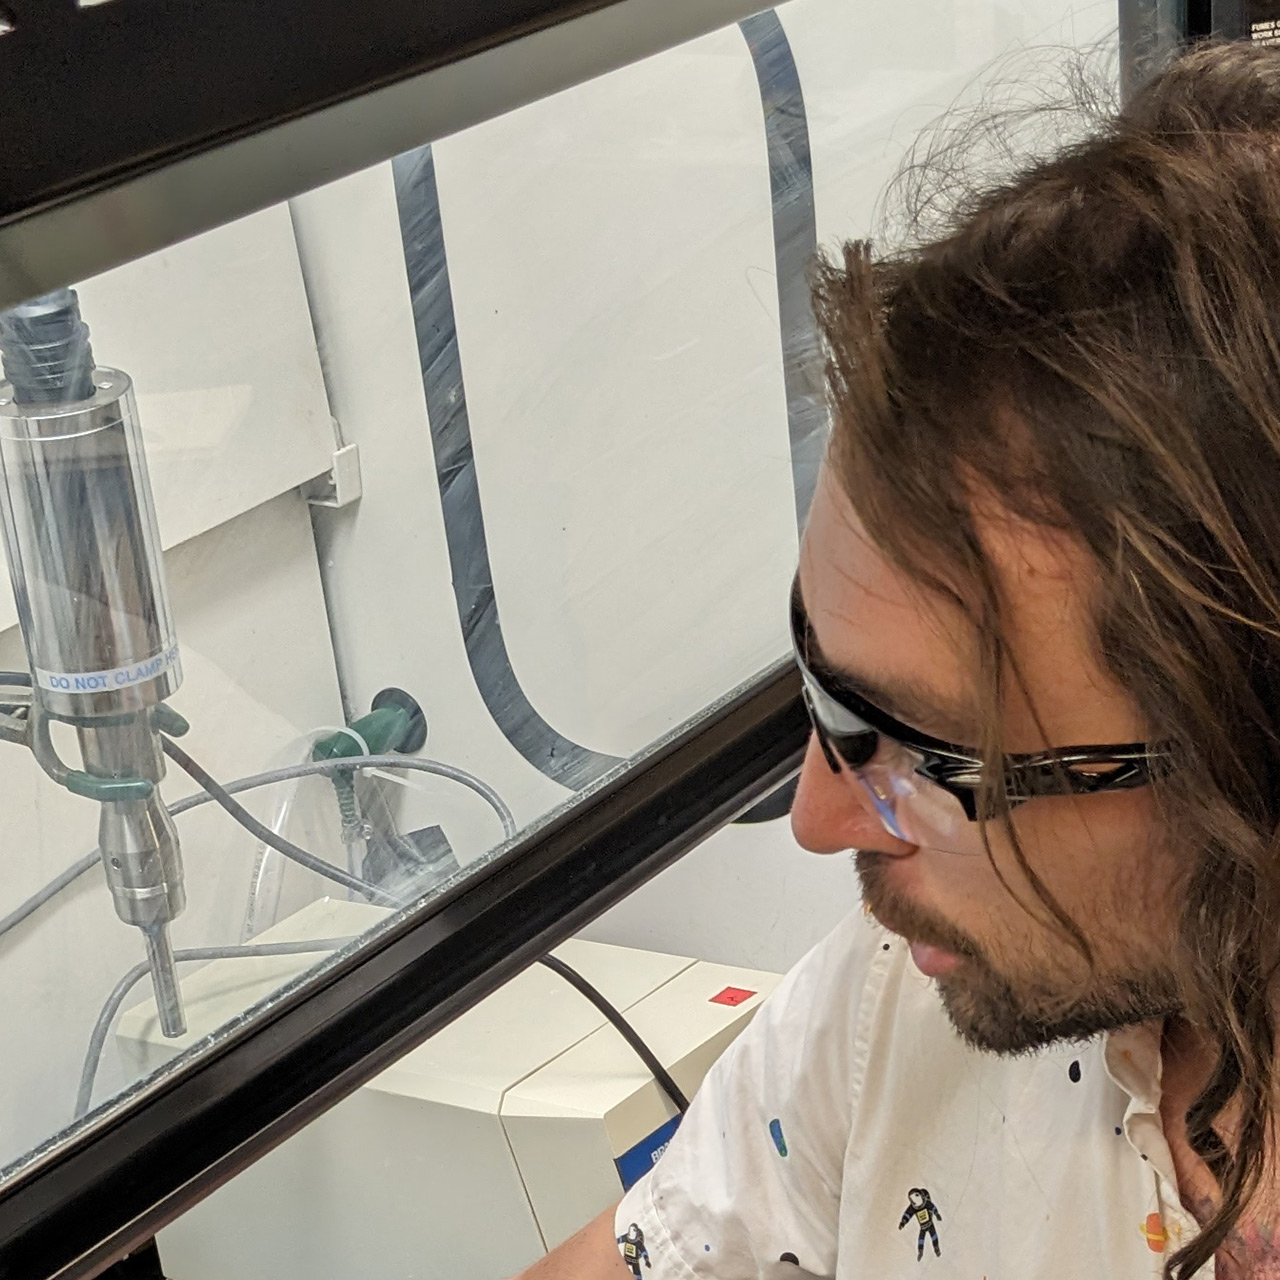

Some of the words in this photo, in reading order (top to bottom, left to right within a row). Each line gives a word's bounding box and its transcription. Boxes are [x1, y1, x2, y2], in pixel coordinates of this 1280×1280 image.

[1251, 29, 1273, 40] WORK
[49, 676, 70, 689] DO
[75, 675, 108, 690] NOT
[114, 658, 163, 686] CLAMP
